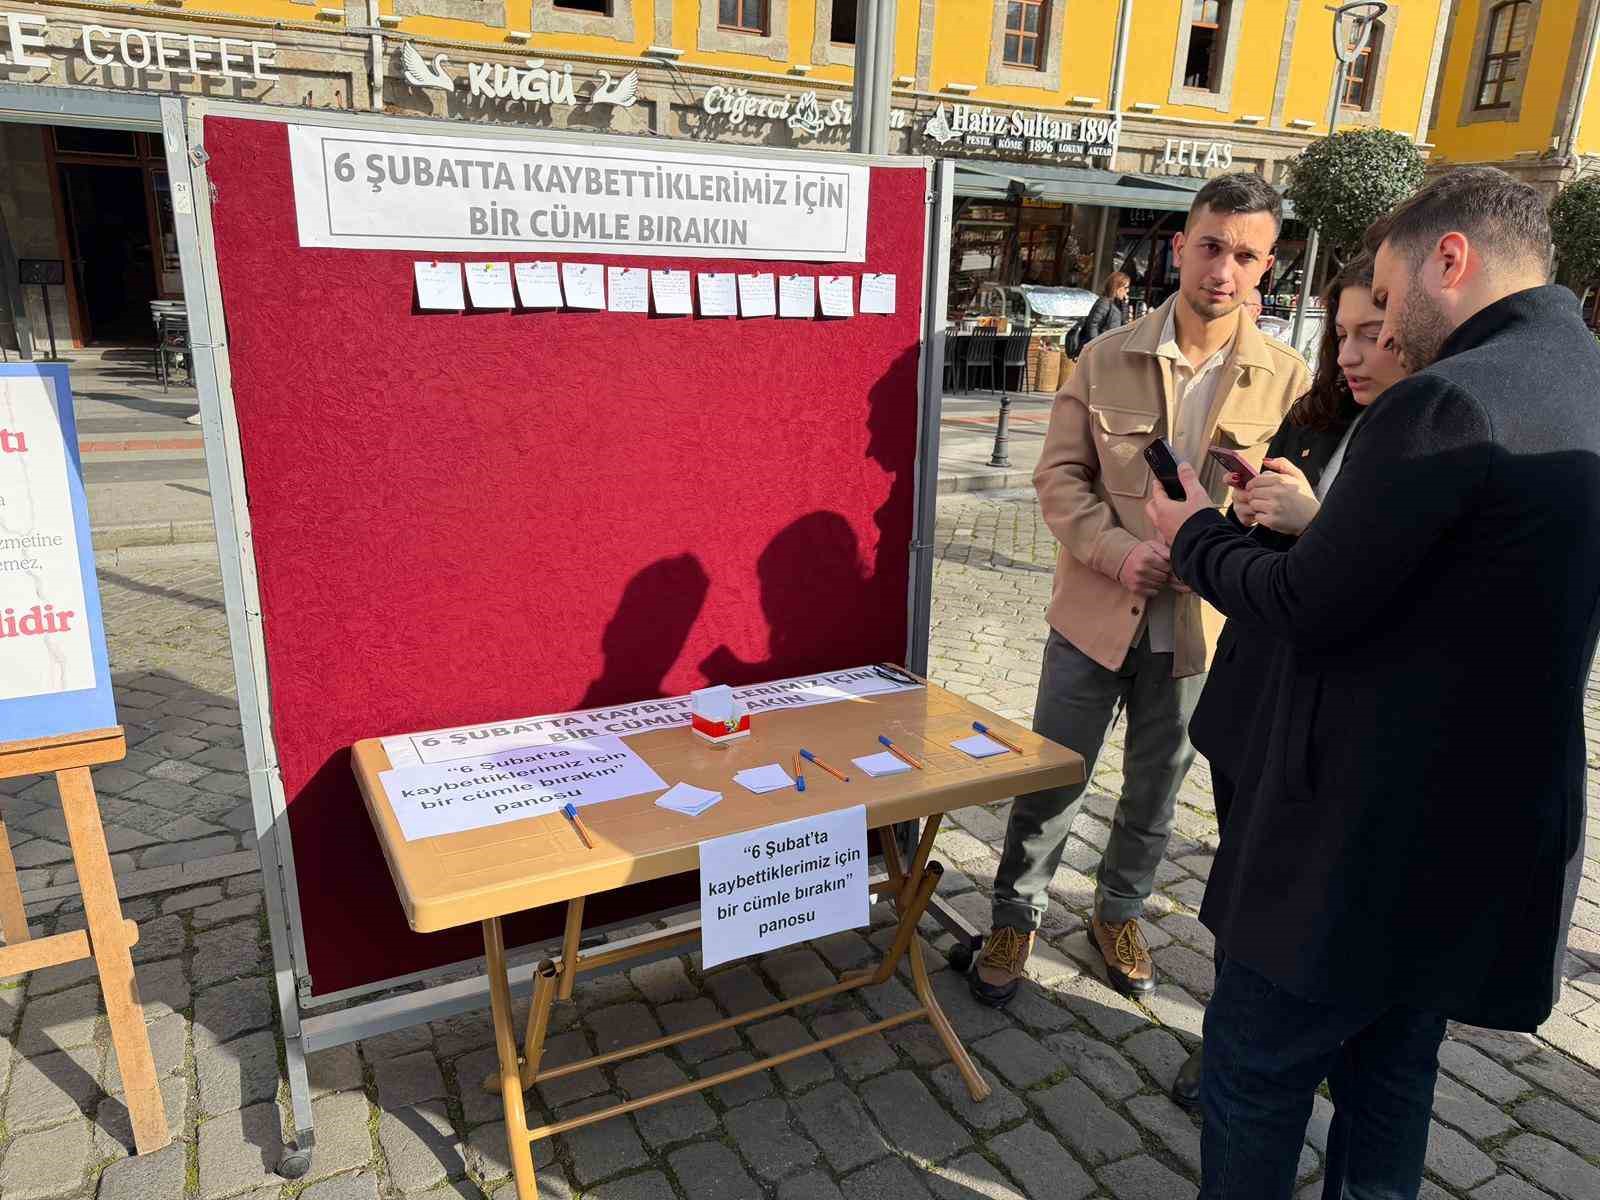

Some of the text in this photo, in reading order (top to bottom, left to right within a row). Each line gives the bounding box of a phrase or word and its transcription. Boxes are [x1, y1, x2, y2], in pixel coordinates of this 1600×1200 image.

[83, 25, 279, 81] COFFEE
[704, 85, 791, 125] Ciğerci
[1010, 109, 1072, 142] Sultan
[1078, 117, 1121, 145] 1896
[998, 137, 1024, 151] KÖME
[1029, 139, 1053, 153] 1896
[1088, 144, 1112, 156] AKTAR
[334, 152, 843, 215] 6 ŞUBATTA KAYBETTİKLERİMİZ İÇİN
[469, 201, 748, 245] BİR CÜMLE BIRAKIN
[421, 737, 441, 748] 6
[450, 715, 583, 745] ŞUBATTA
[823, 668, 874, 685] İÇİN
[549, 726, 597, 743] BİR
[605, 711, 692, 734] CÜMLE
[401, 750, 628, 799] kaybettiklerimiz için
[421, 797, 453, 811] bir
[462, 782, 534, 803] cümle
[493, 788, 583, 815] panosu
[708, 848, 861, 897] kaybettiklerimiz için
[717, 903, 739, 920] bir
[743, 891, 791, 913] cümle
[758, 910, 816, 938] panosu
